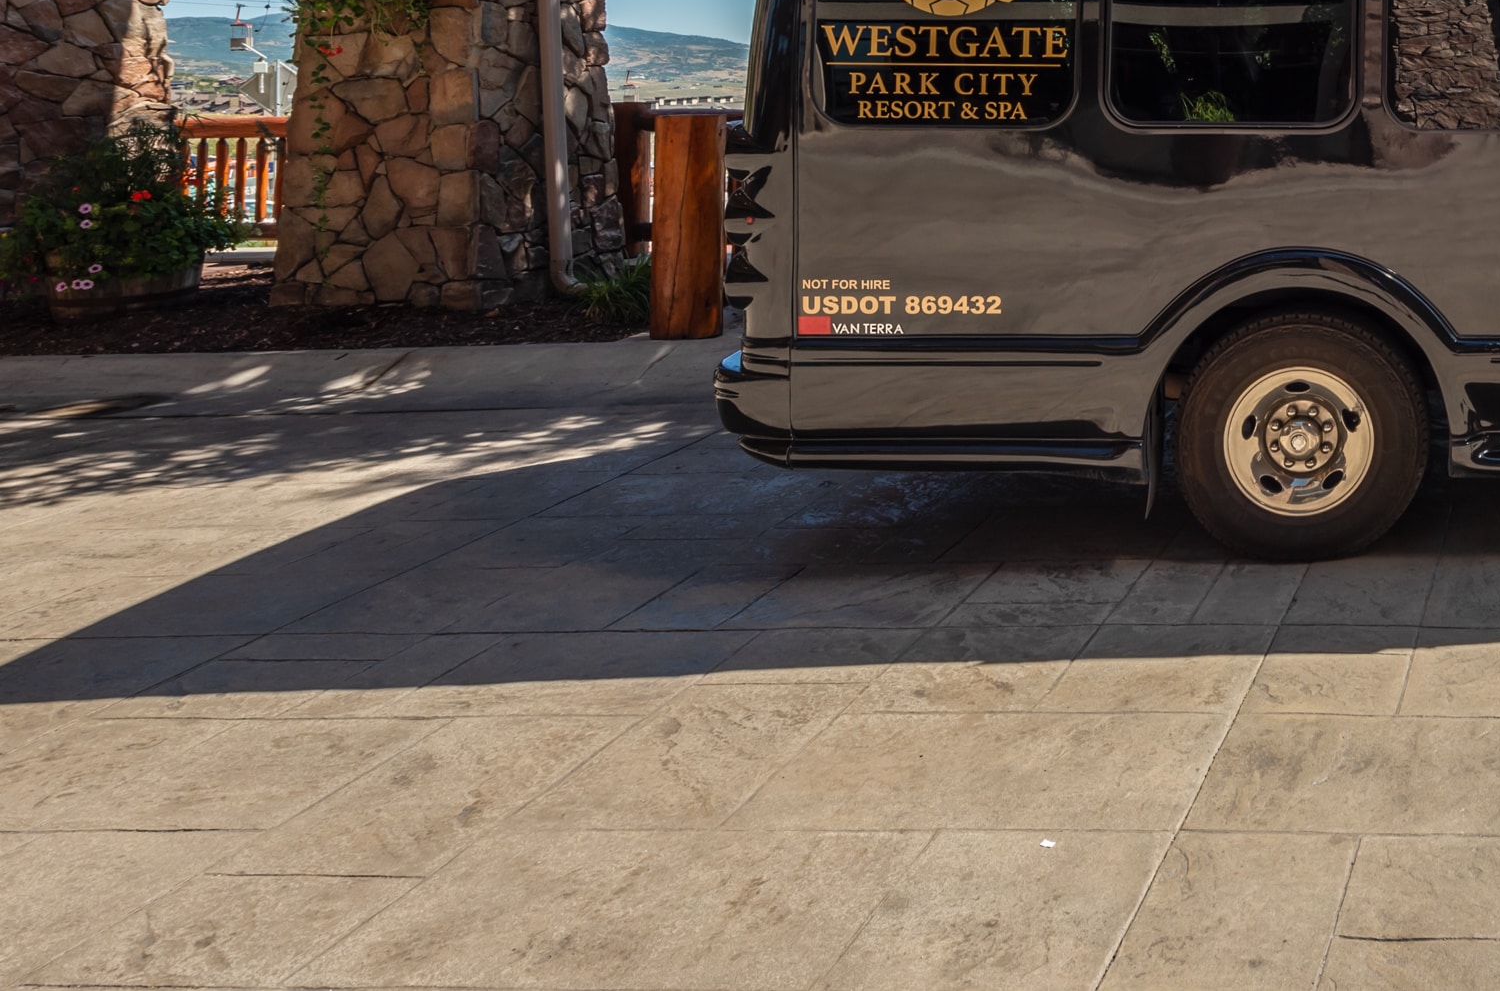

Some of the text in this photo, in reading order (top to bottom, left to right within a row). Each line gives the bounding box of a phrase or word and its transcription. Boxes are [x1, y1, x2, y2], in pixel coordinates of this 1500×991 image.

[821, 24, 1069, 59] WESTGATE
[848, 72, 1038, 96] PARK CITY
[857, 100, 1028, 120] RESORT & SPA
[802, 279, 891, 290] NOT FOR HIRE
[802, 295, 1002, 315] USDOT 869432
[832, 322, 904, 335] VAN TERRA
